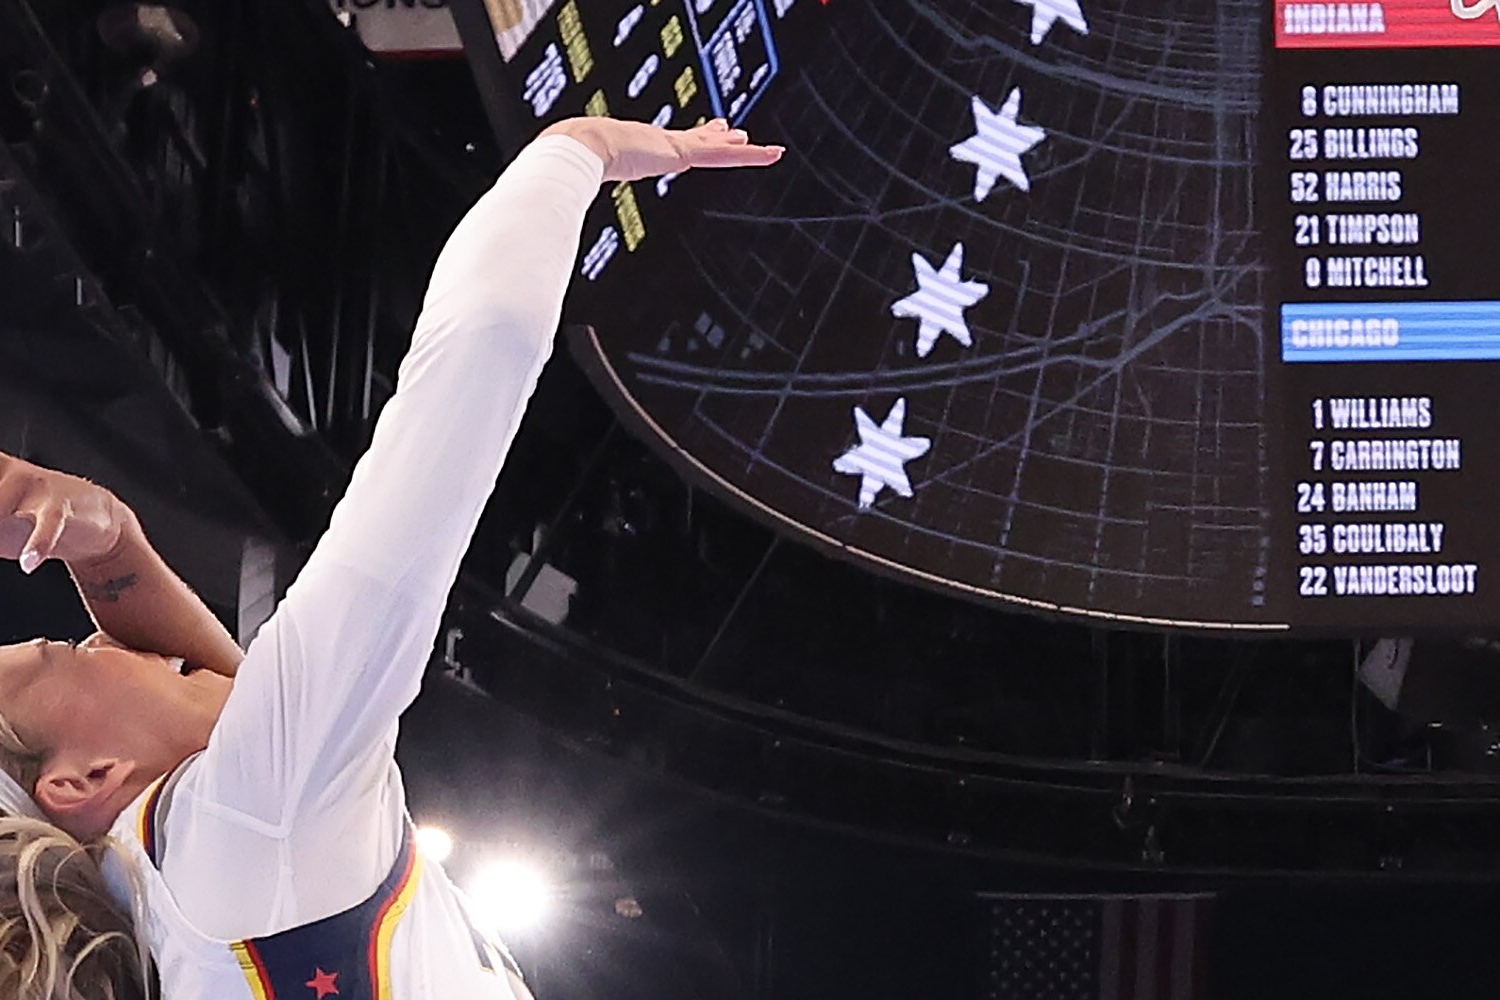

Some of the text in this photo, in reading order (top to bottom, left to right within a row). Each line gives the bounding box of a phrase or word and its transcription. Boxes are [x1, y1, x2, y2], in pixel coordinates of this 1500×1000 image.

[1284, 3, 1385, 34] INDIANA
[1302, 84, 1459, 117] 8 CUNNINGHAM
[1289, 127, 1419, 159] 25 BILLINGS
[1291, 171, 1402, 202] 52 HARRIS
[1295, 213, 1419, 245] 21 TIMPSON
[1305, 255, 1429, 287] 0 MITCHELL
[1291, 318, 1400, 348] CHICAGO
[1312, 397, 1432, 429] 1 WILLIAMS
[1310, 439, 1460, 471] 7 CARRINGTON
[1297, 481, 1416, 513] 24 BANHAM
[1299, 523, 1444, 554] 35 COULIBALY
[1299, 564, 1478, 596] 22 VANDERSLOOT
